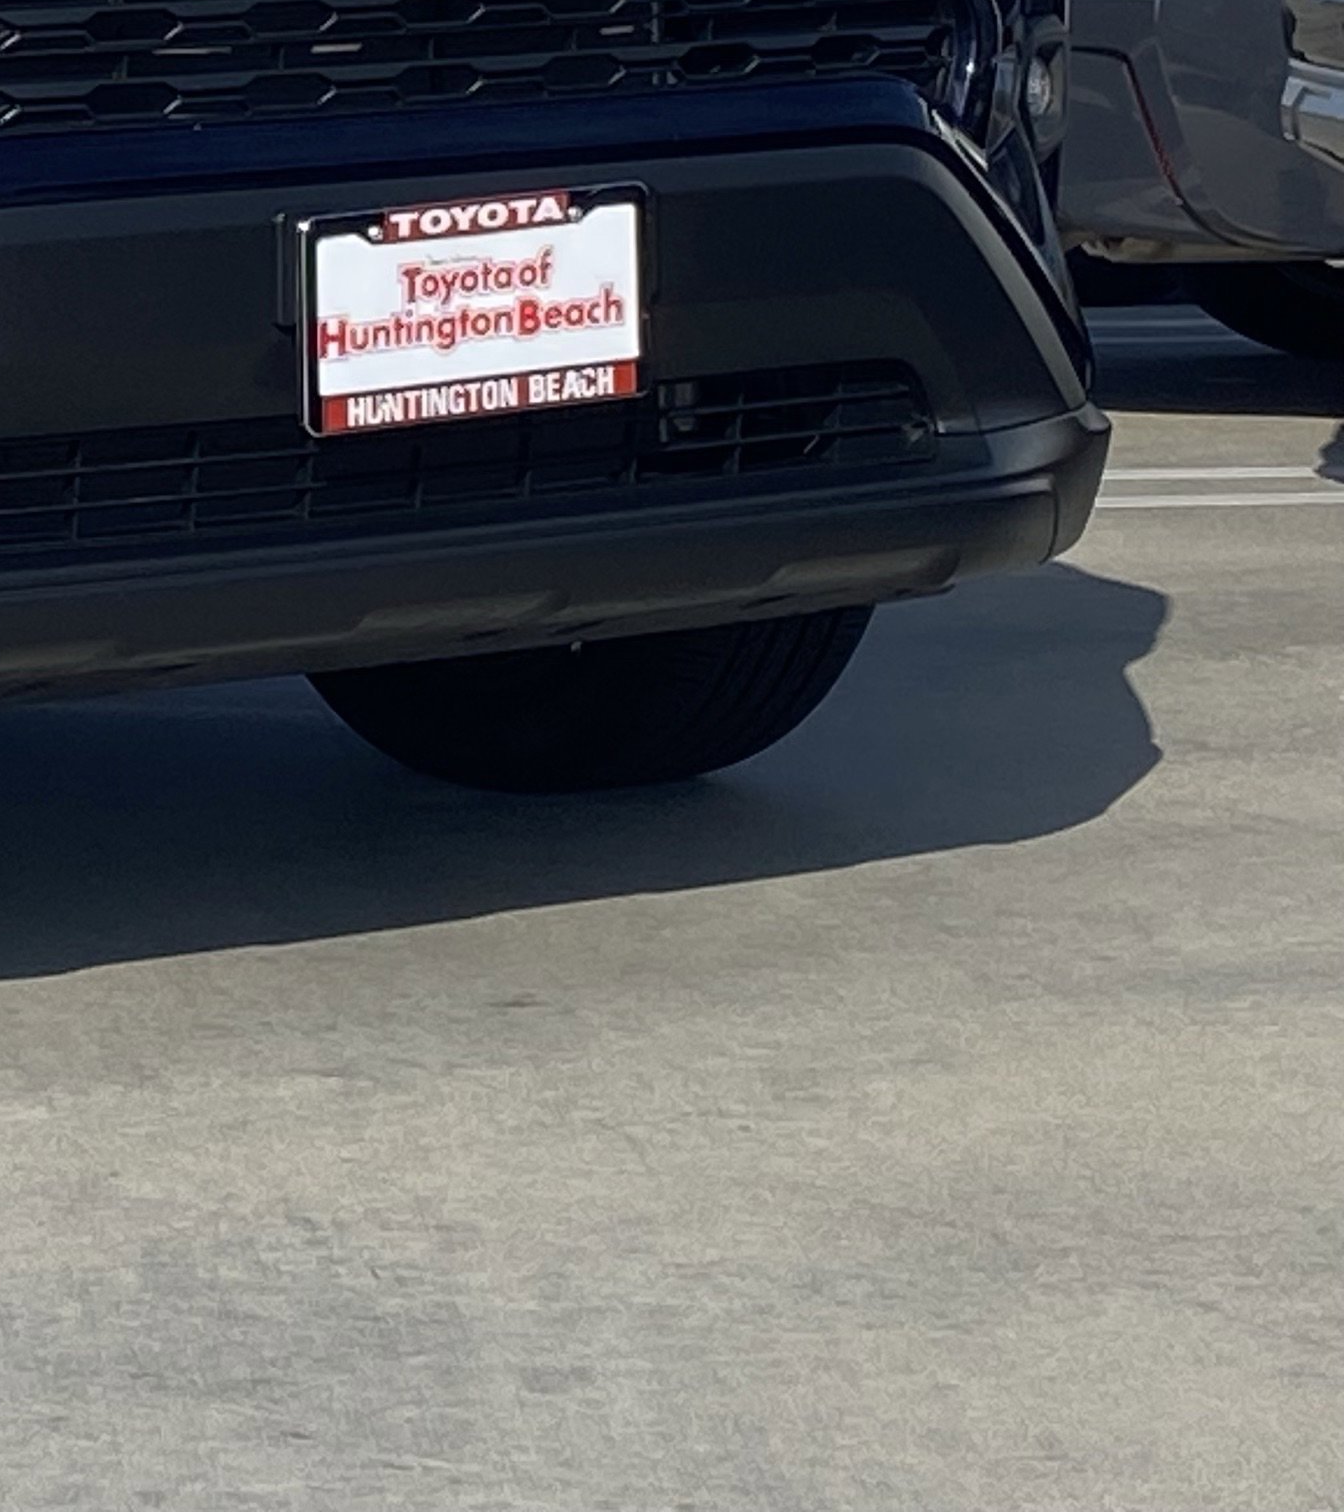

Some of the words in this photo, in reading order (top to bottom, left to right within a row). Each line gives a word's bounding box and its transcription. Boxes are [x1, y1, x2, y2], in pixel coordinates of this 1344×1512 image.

[390, 196, 563, 238] TOYOTA
[401, 261, 512, 303] Toyota
[518, 248, 553, 287] of
[318, 310, 513, 359] Huntington
[516, 287, 623, 336] Beach
[346, 378, 518, 428] HUNTINGTON
[528, 366, 615, 405] BEACH
